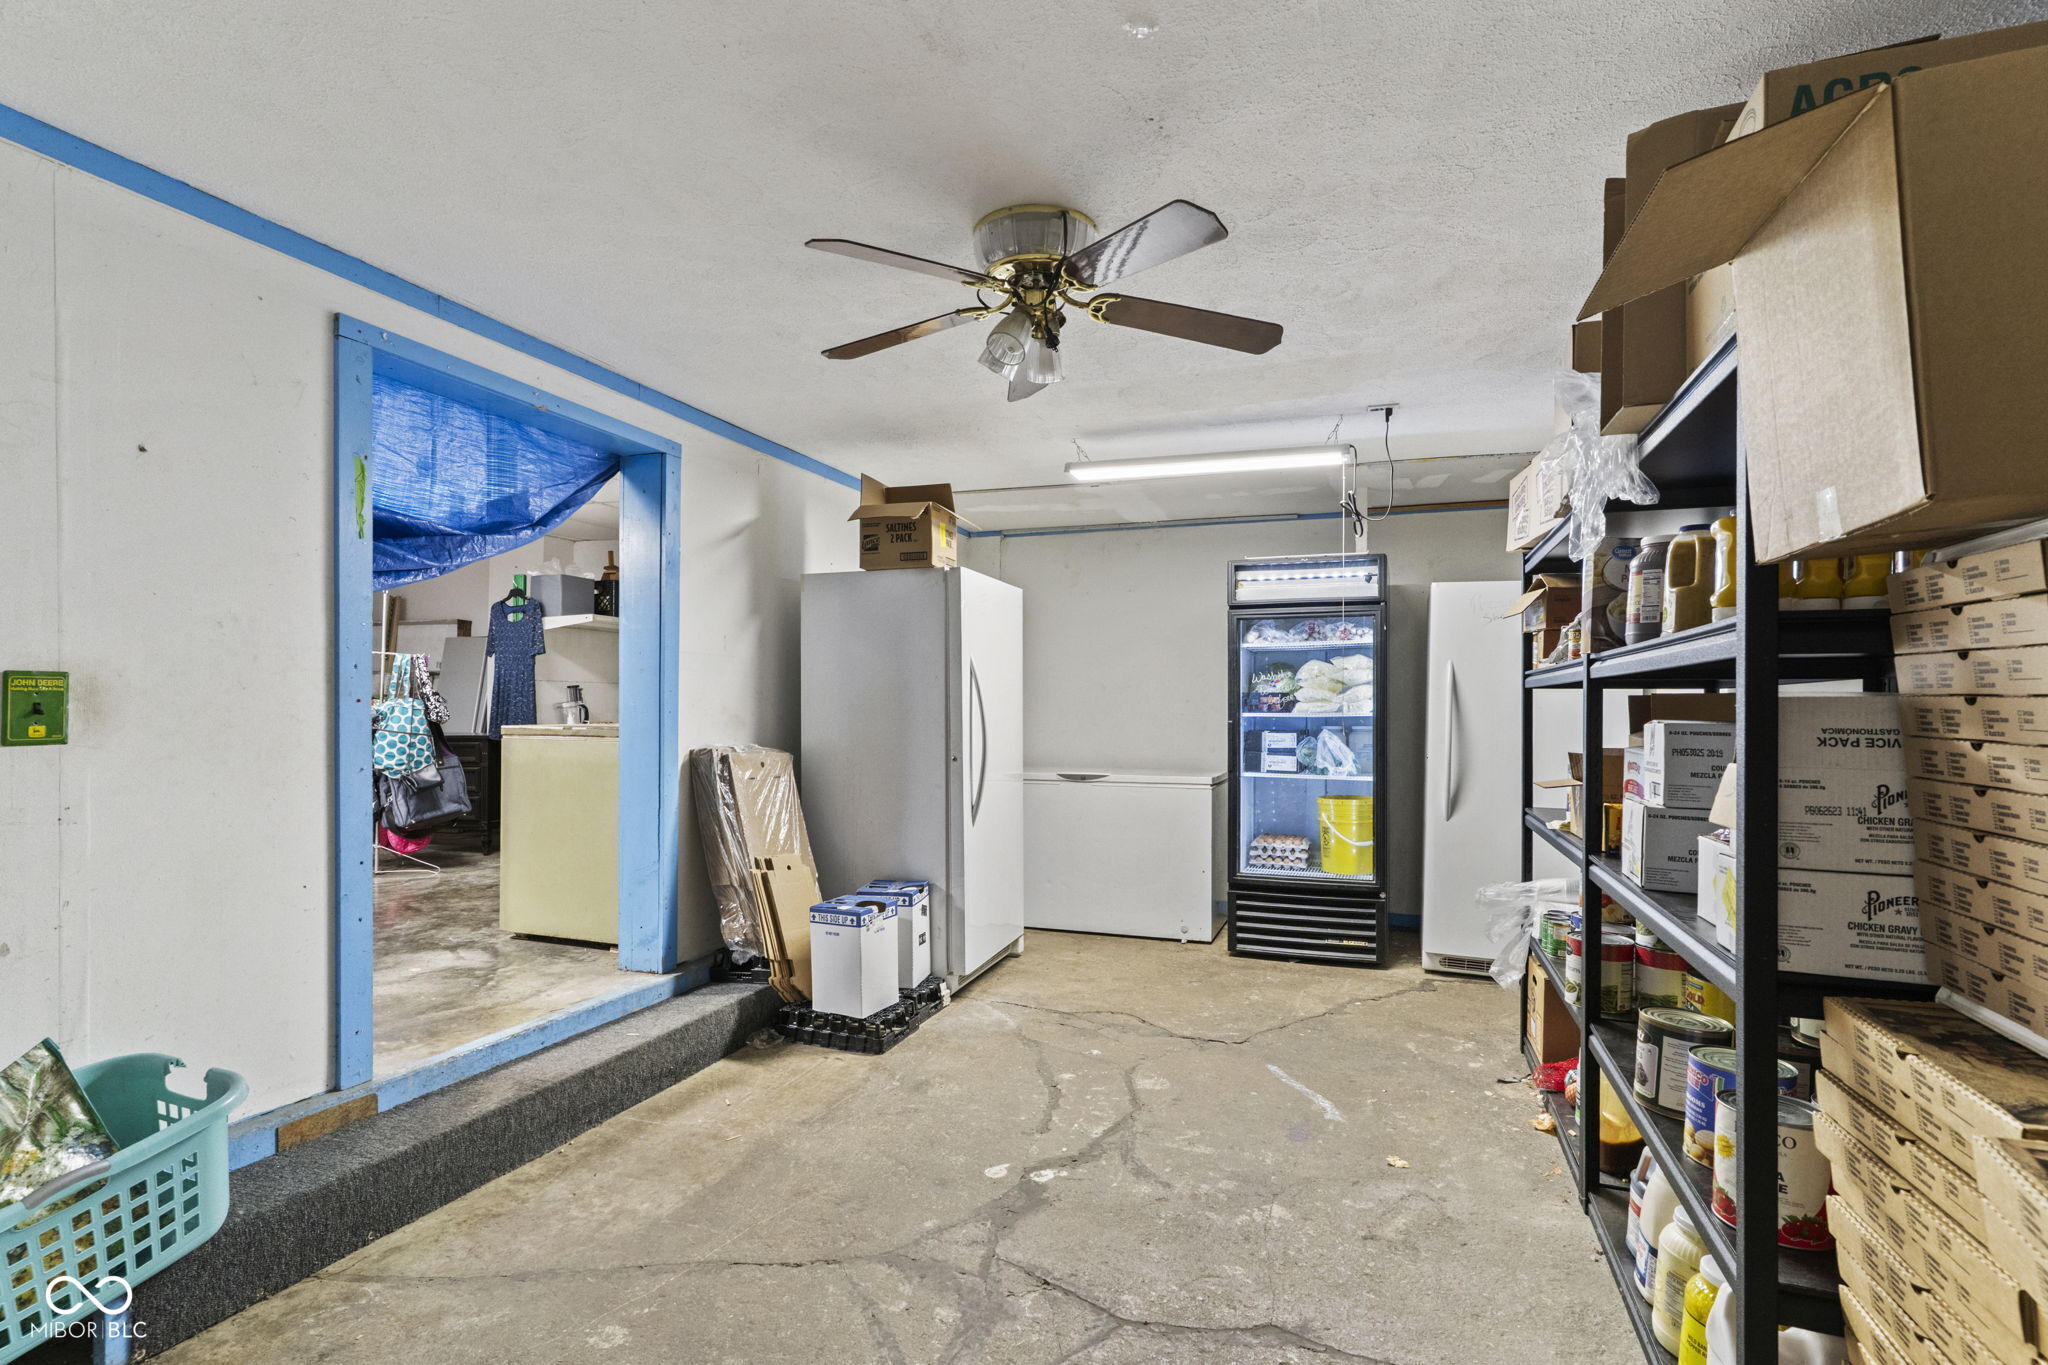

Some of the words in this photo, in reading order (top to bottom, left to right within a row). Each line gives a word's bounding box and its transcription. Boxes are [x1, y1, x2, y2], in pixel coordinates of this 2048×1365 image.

[1790, 66, 1922, 117] AC
[886, 521, 917, 533] SALTINES
[890, 534, 895, 543] 2
[895, 533, 912, 543] PACK
[1821, 727, 1901, 737] GASTRONÓMICA
[1816, 736, 1860, 748] PACK
[1865, 737, 1902, 749] VICE
[1857, 815, 1896, 826] CHICKEN
[1862, 890, 1919, 922] PIONEER
[818, 914, 829, 923] THIS
[829, 915, 841, 924] SIDE
[1847, 921, 1886, 933] CHICKEN
[1887, 924, 1918, 936] GRAVY
